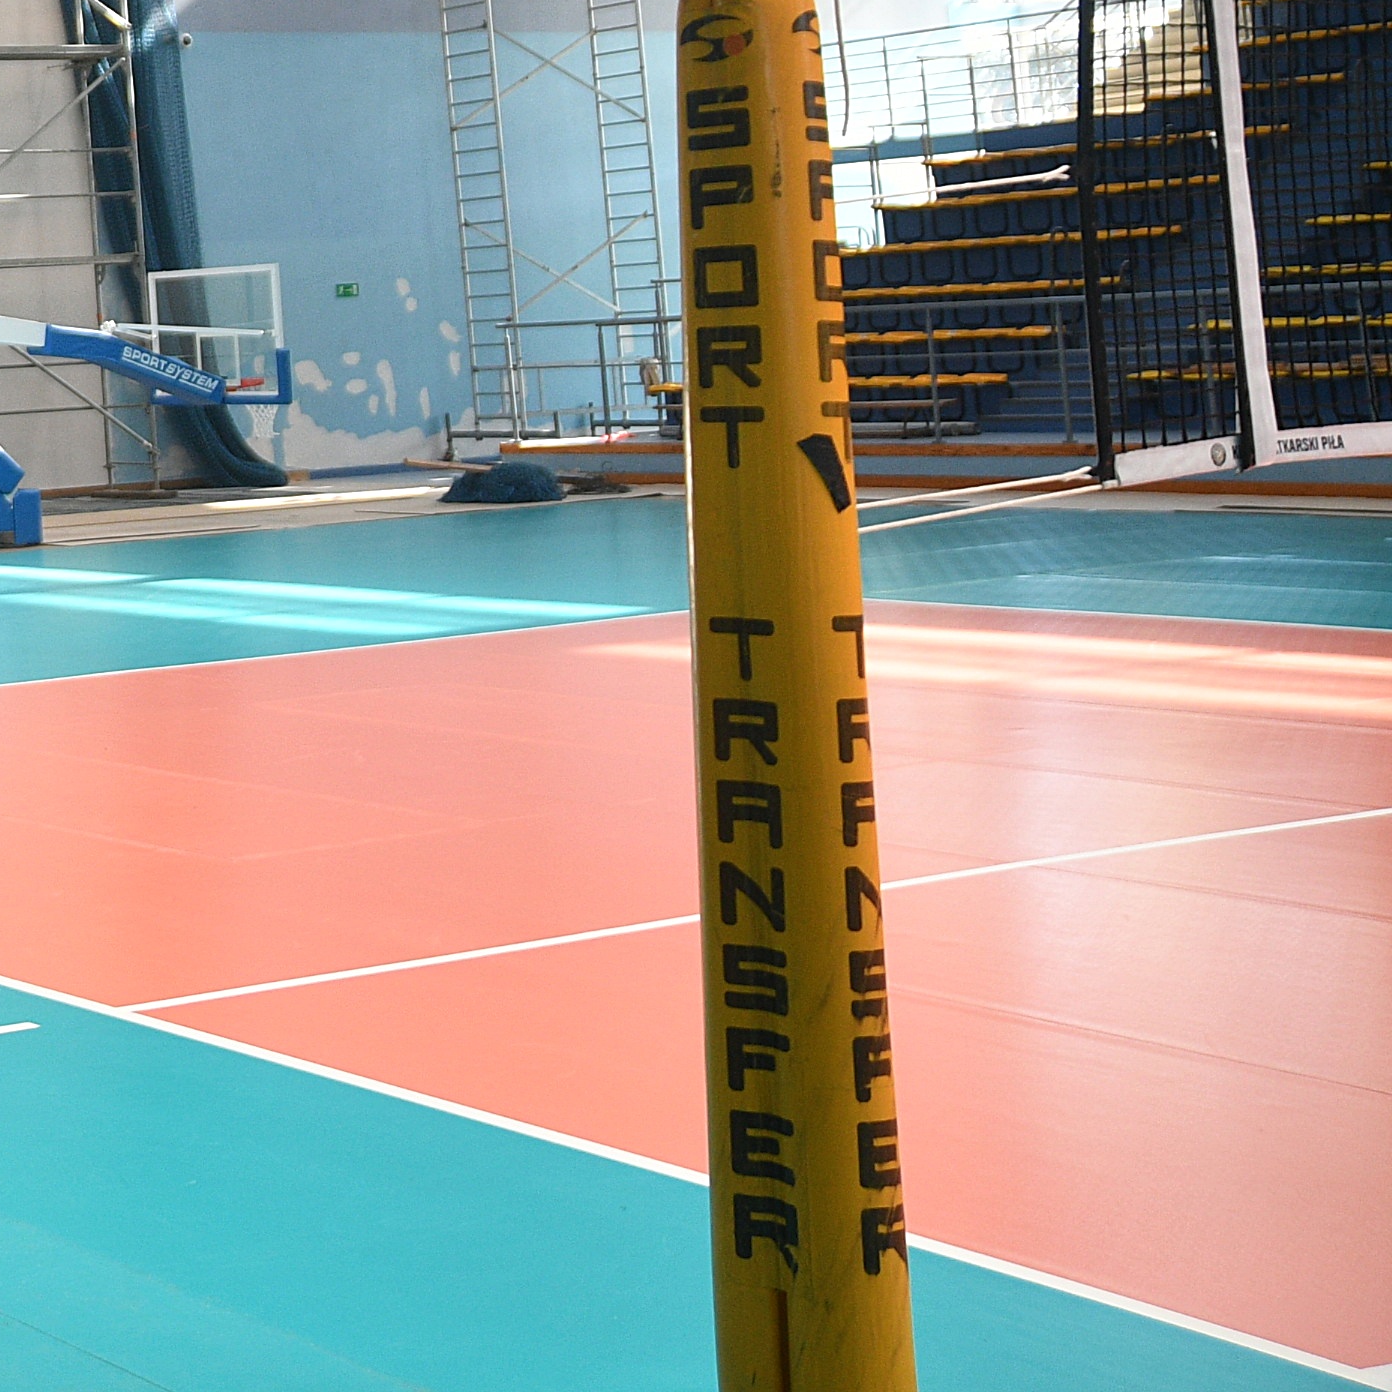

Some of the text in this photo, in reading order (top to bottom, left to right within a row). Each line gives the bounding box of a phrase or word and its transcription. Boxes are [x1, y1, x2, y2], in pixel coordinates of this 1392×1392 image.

[122, 346, 218, 390] SPORTSYSTEM
[686, 85, 764, 468] SPORT
[1276, 434, 1345, 455] TKARSKI PIŁA
[710, 616, 799, 1275] TRANSFER
